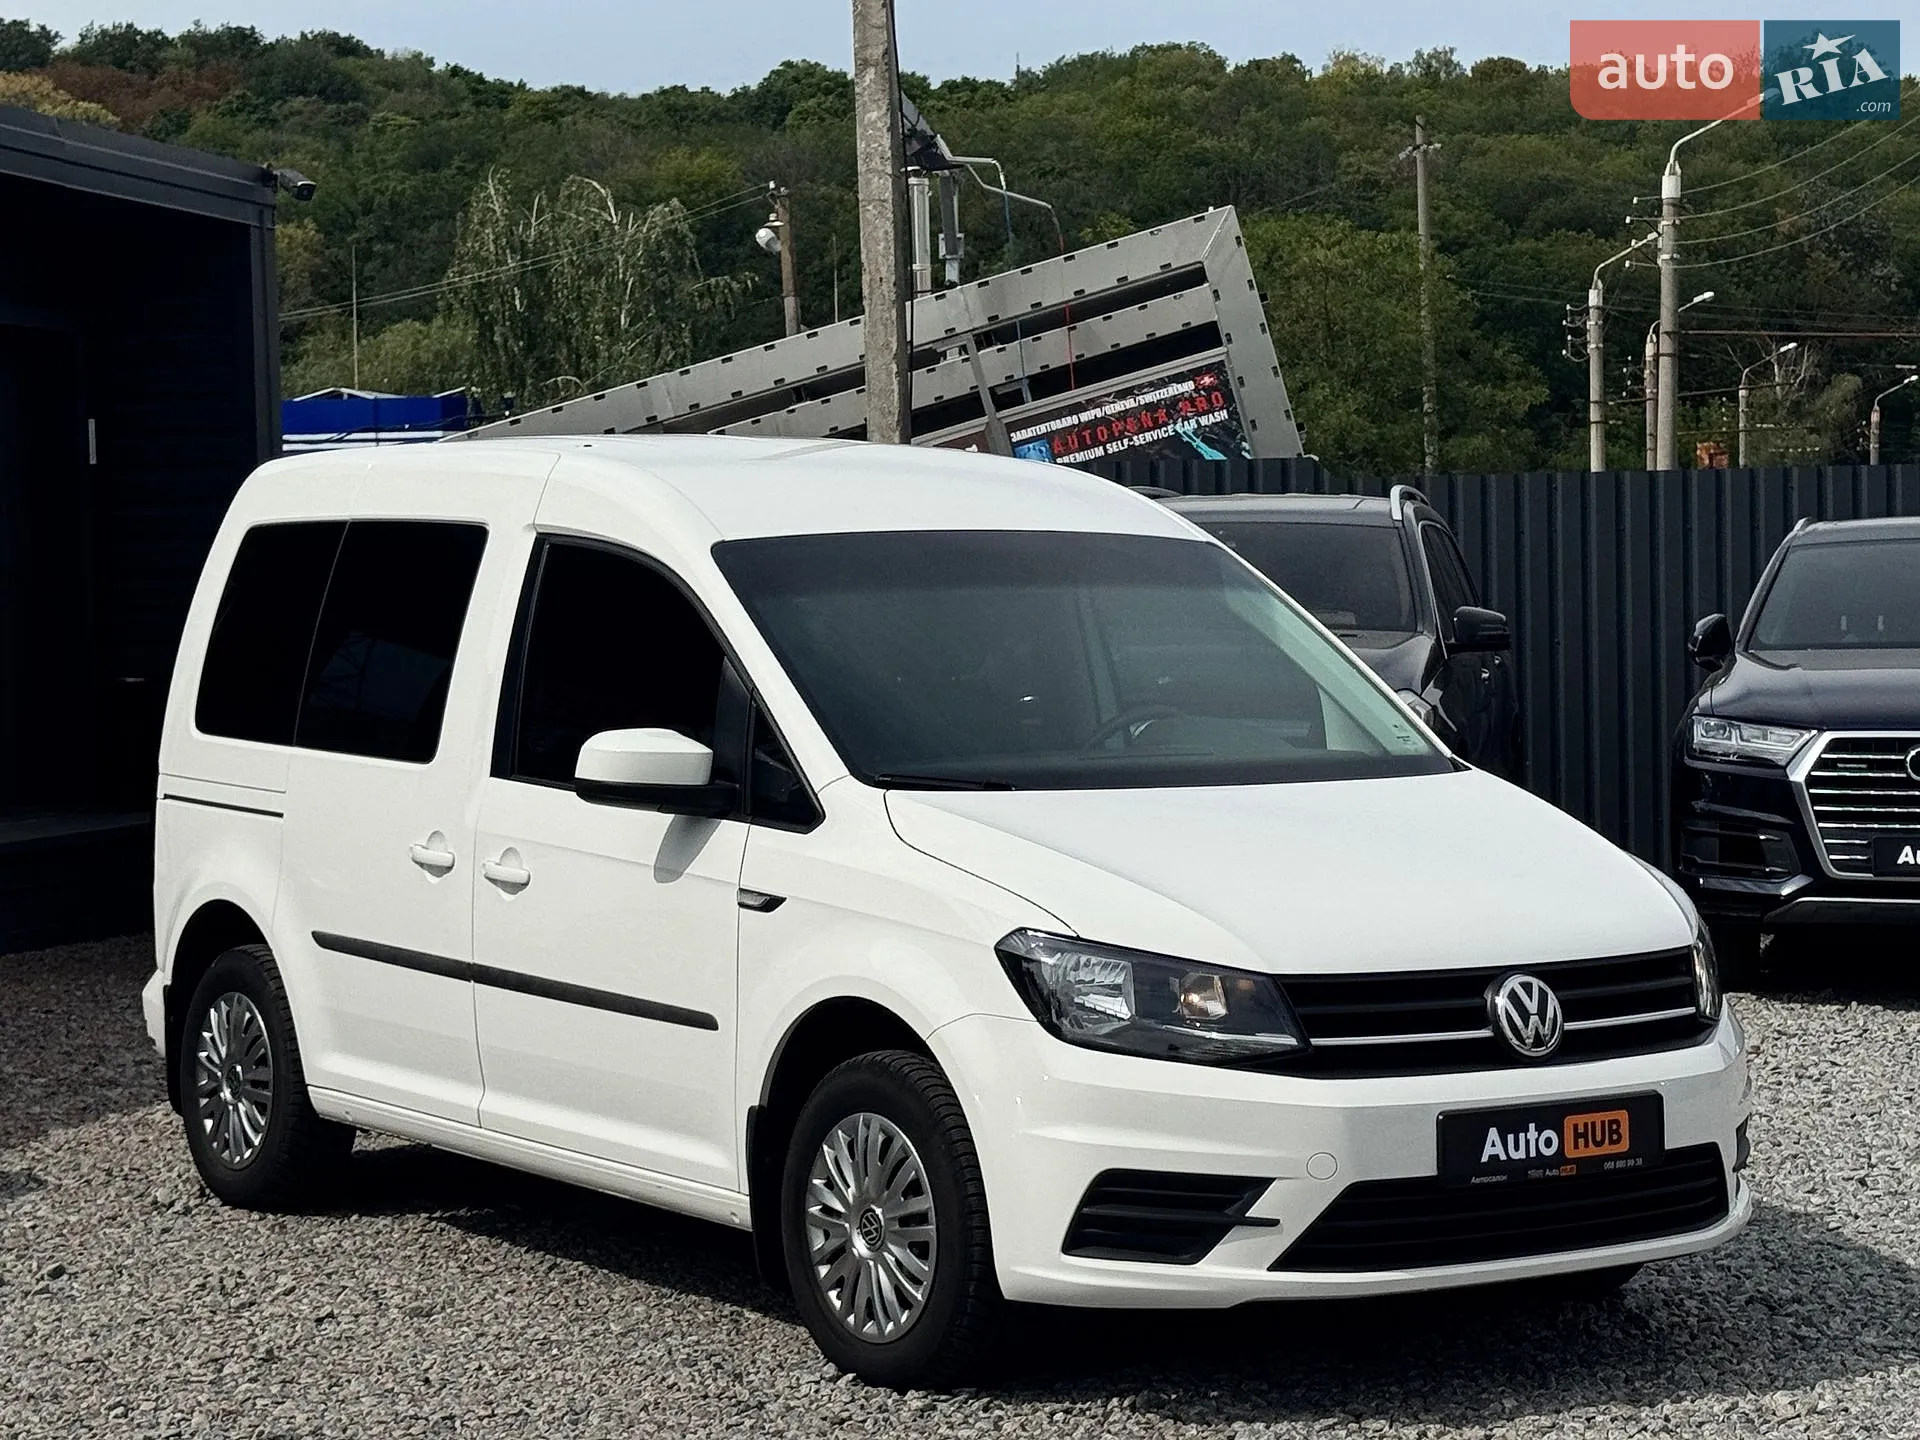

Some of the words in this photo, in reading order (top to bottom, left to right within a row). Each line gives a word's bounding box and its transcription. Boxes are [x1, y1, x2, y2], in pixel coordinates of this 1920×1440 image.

[1106, 426, 1175, 455] SELF-SERVICE
[1198, 409, 1229, 427] WASH
[1480, 1122, 1559, 1163] Auto
[1572, 1118, 1623, 1150] HUB
